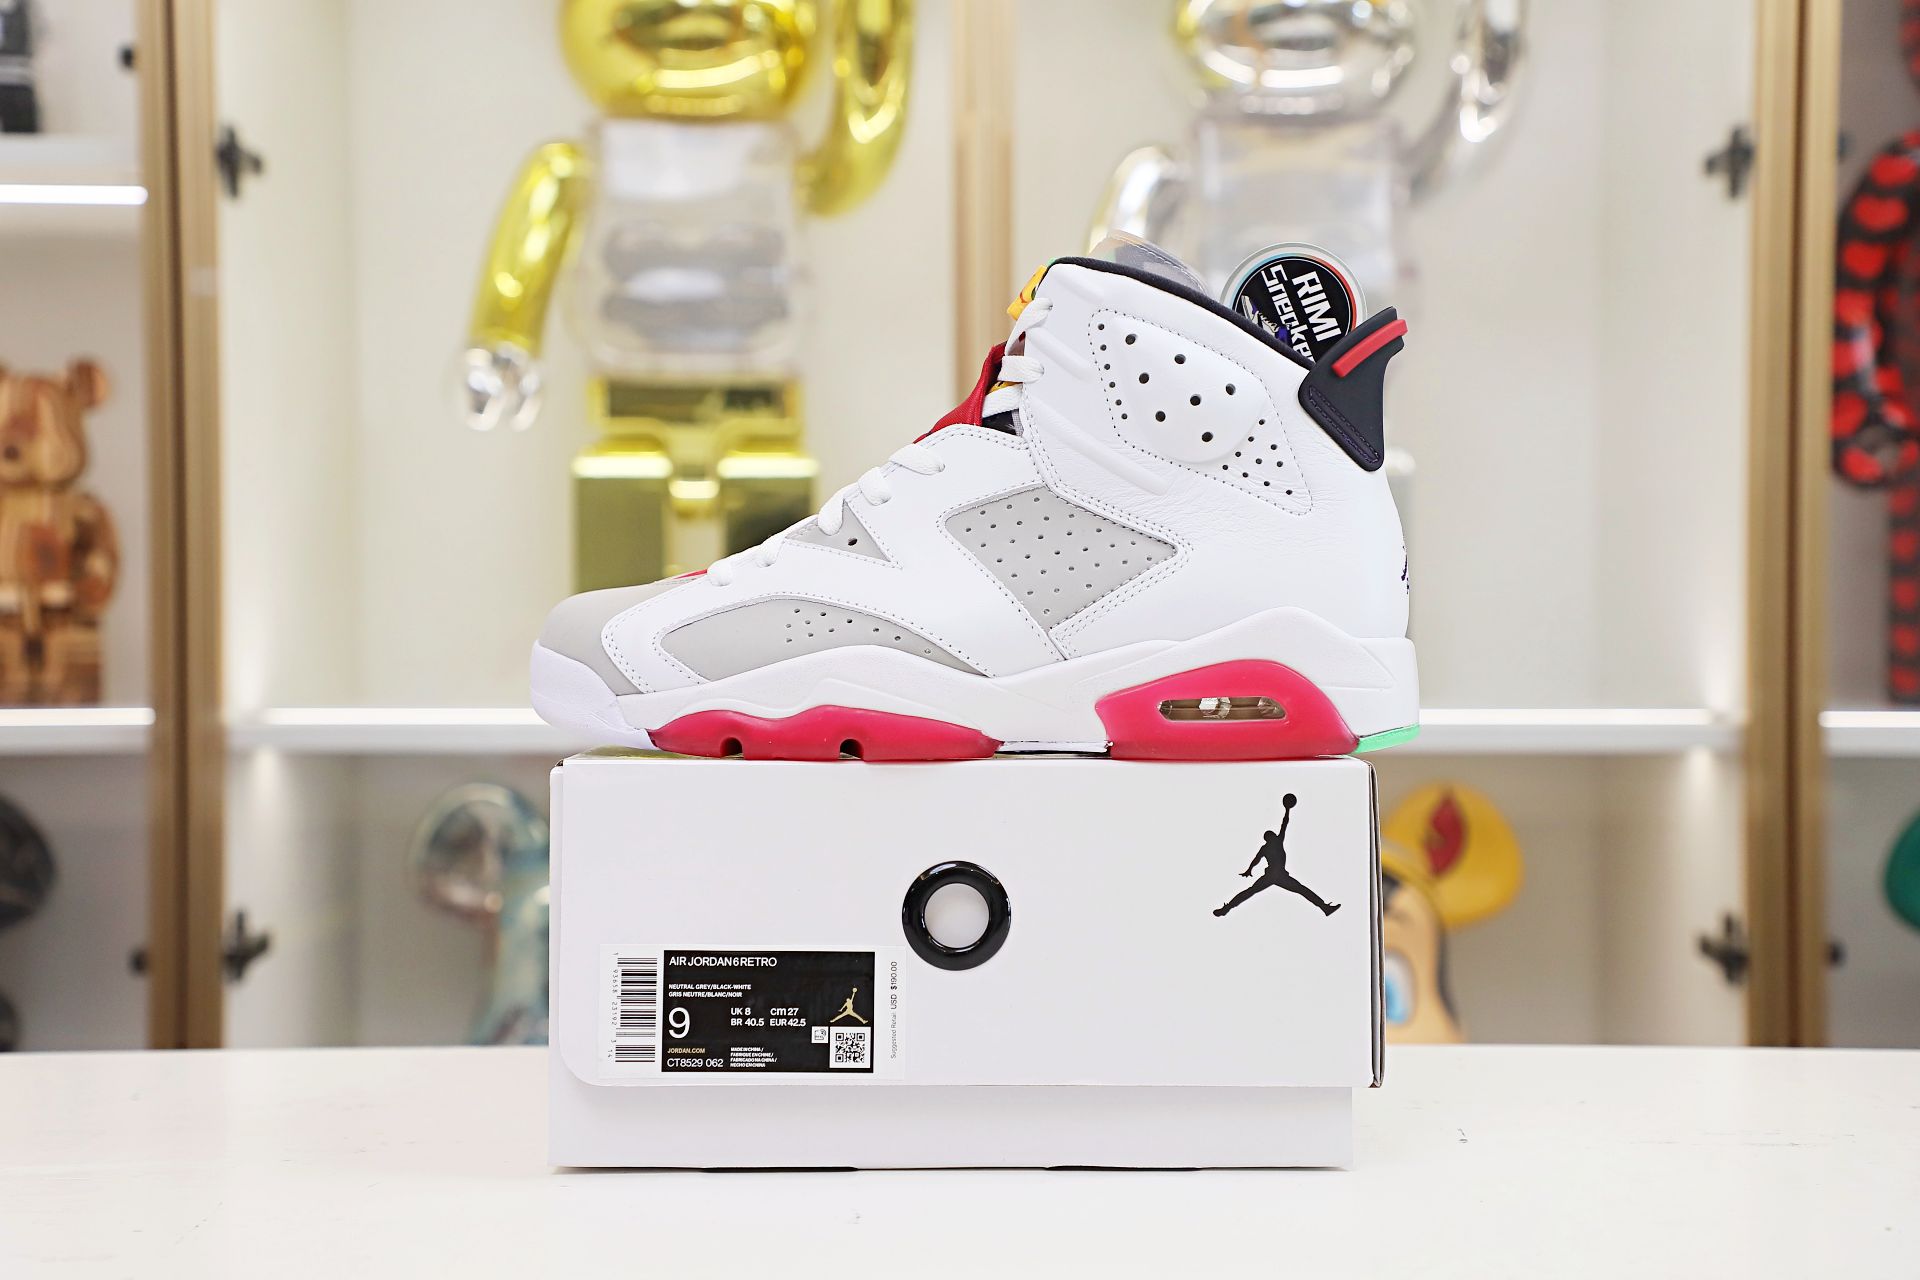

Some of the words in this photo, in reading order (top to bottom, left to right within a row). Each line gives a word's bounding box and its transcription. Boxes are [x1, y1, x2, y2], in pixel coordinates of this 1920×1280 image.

[1292, 271, 1342, 341] RIMI
[669, 956, 686, 966] AIR
[688, 956, 732, 967] JORDAN
[733, 957, 739, 967] 6
[740, 957, 778, 967] RETRO
[890, 961, 898, 990] $190.00
[730, 1007, 742, 1016] UK
[744, 1007, 751, 1016] 8
[787, 1007, 799, 1016] 27
[668, 1007, 690, 1039] 9
[730, 1018, 742, 1026] BR
[744, 1018, 765, 1027] 40.5
[769, 1018, 787, 1027] EUR
[787, 1018, 806, 1027] 42.5
[667, 1058, 703, 1068] CT8529
[705, 1058, 724, 1068] 062
